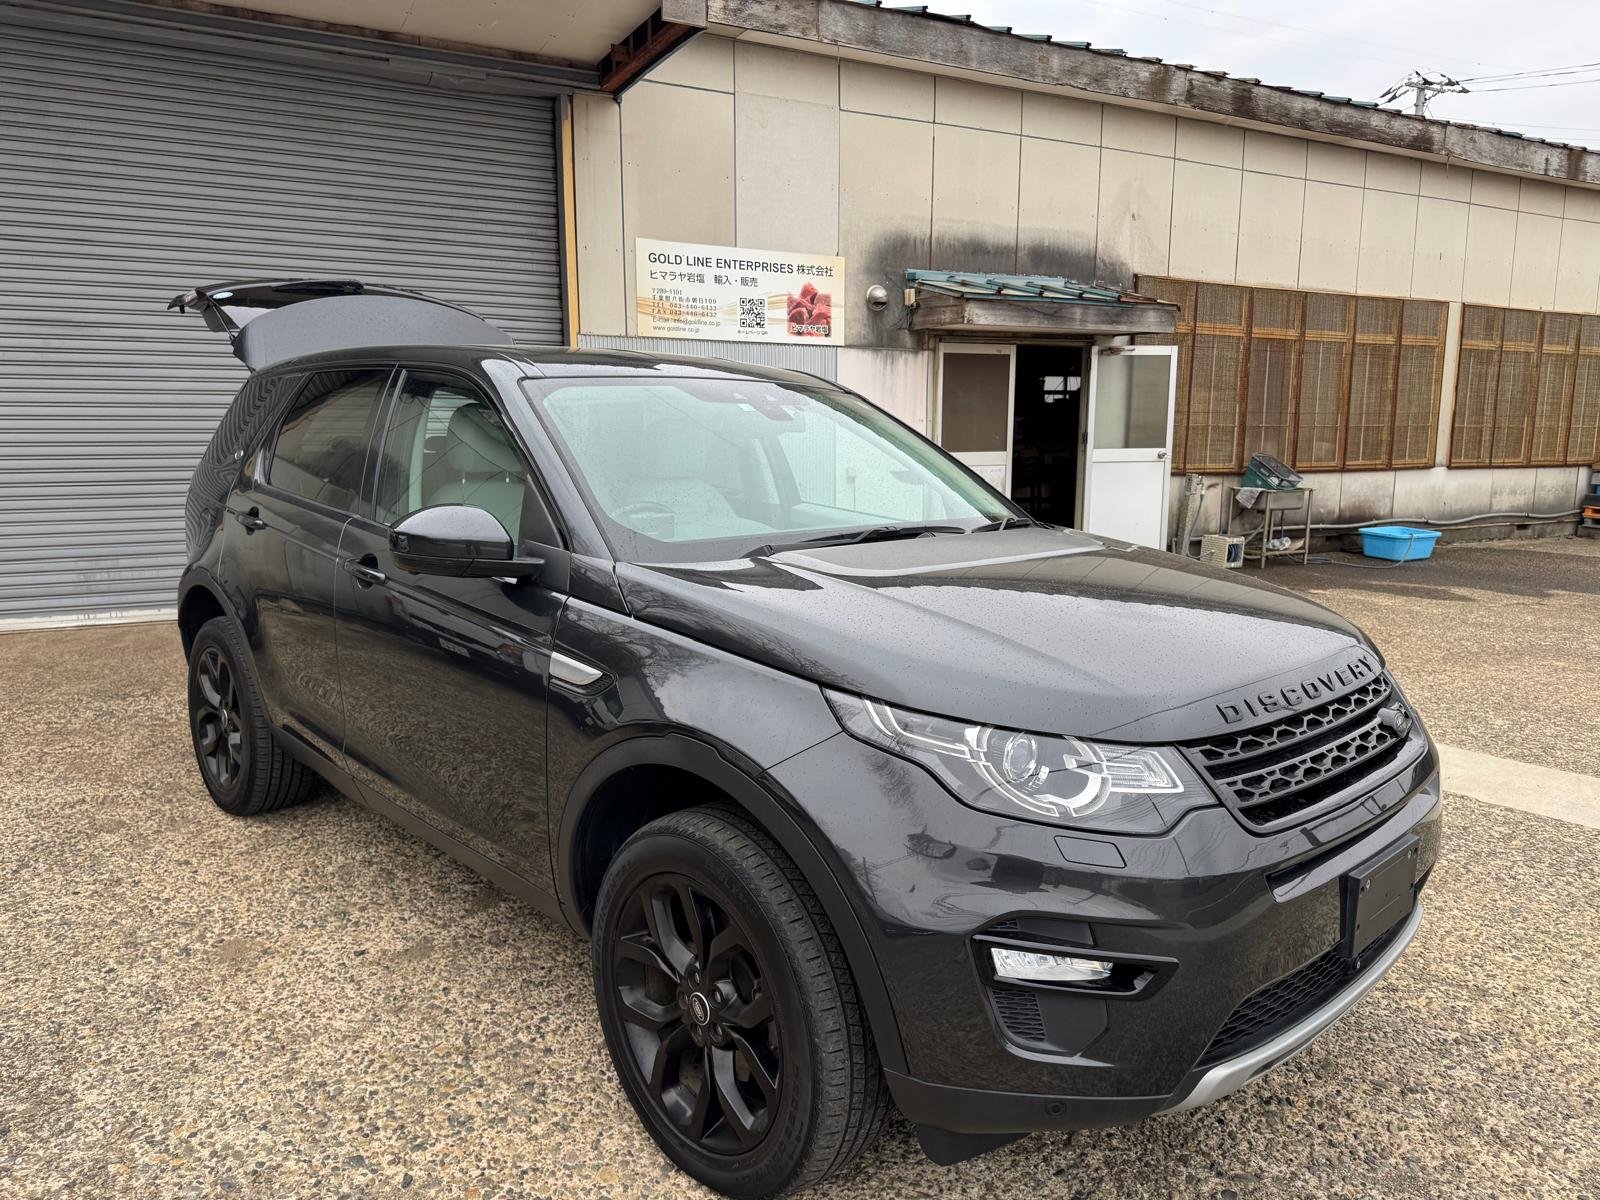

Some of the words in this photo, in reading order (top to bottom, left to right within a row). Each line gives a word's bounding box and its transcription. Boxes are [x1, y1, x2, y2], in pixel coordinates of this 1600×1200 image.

[648, 252, 682, 265] GOLD
[686, 256, 712, 268] LINE
[716, 258, 794, 274] ENTERPRISES
[796, 263, 834, 277] 株式会社
[650, 269, 705, 284] ヒマラヤ岩塩
[714, 274, 758, 287] 輸入・販売
[1216, 655, 1374, 724] DISCOVERY
